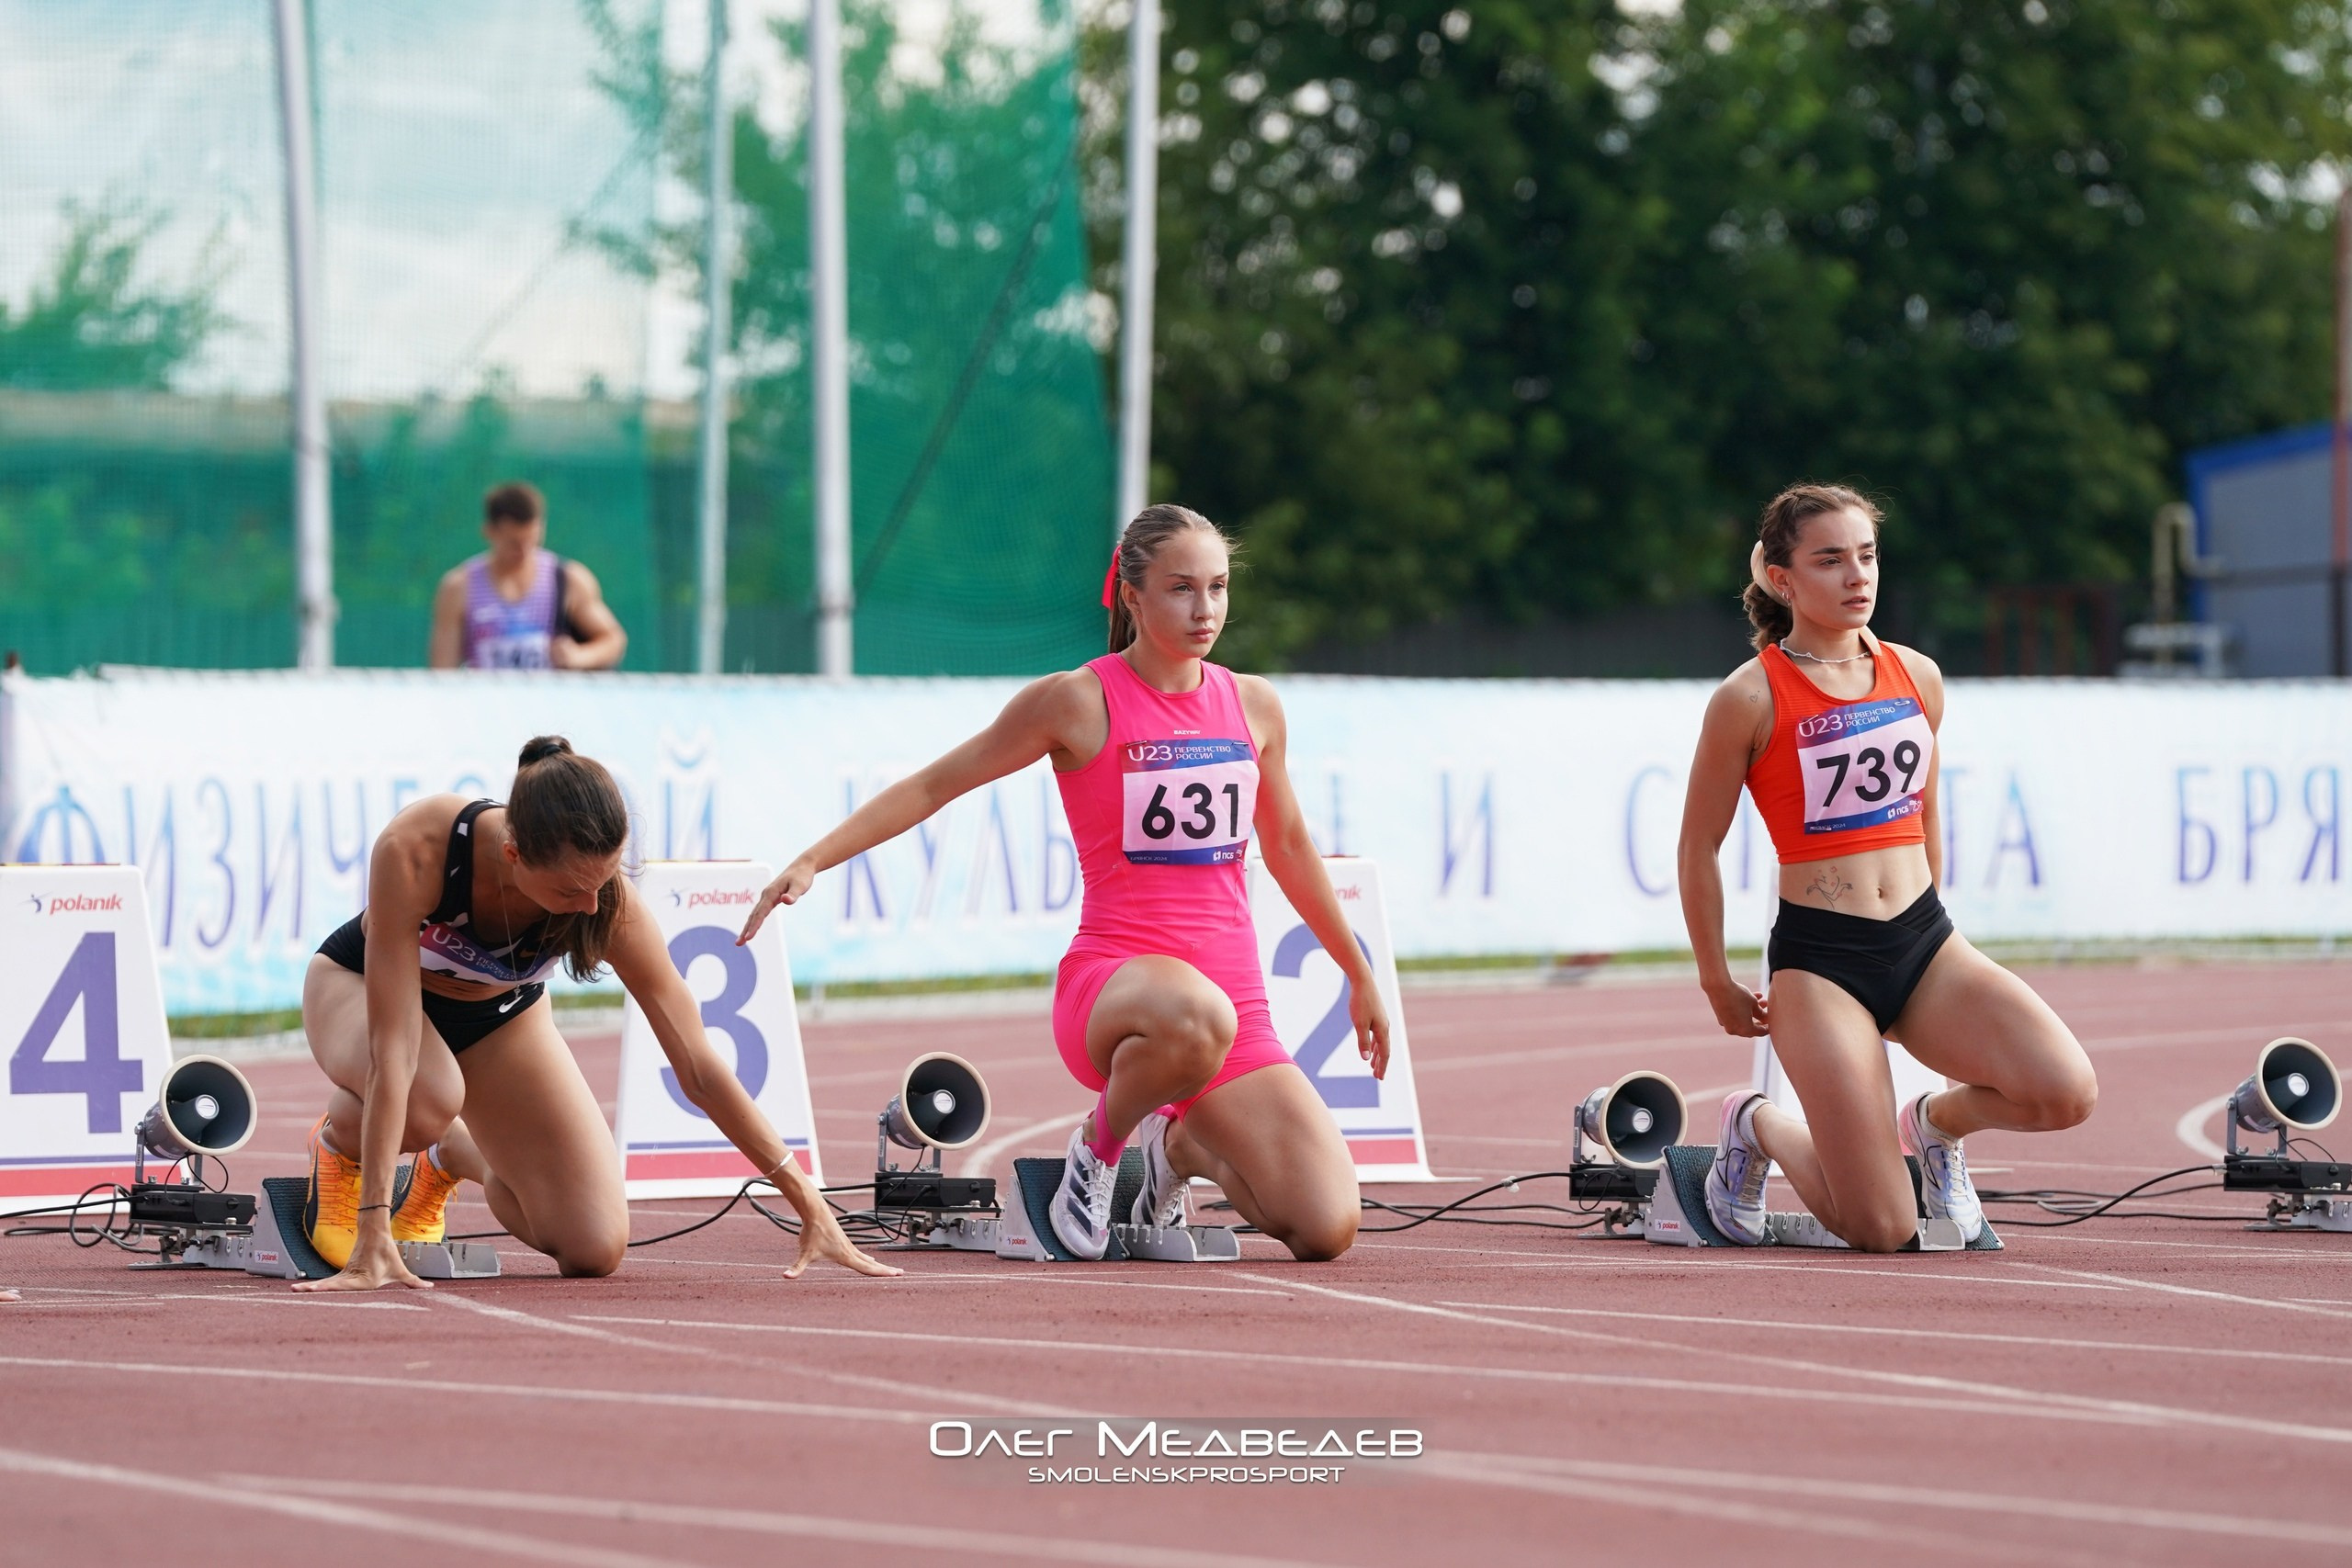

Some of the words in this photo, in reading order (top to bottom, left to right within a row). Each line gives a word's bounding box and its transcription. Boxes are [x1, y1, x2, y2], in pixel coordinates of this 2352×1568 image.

[1844, 706, 1895, 721] ПЕРВЕНСТВО
[1846, 716, 1881, 728] РОССИИ
[1798, 714, 1844, 738] U23
[1127, 745, 1173, 761] U23
[1174, 745, 1231, 753] ПЕРВЕНСТВО
[1175, 752, 1214, 761] РОССИИ
[1815, 739, 1921, 807] 739
[1141, 783, 1238, 840] 631
[1439, 770, 1494, 900] И
[50, 892, 123, 916] polanik
[687, 888, 755, 908] polanik
[432, 927, 476, 962] U23
[660, 925, 769, 1119] 3
[1272, 921, 1380, 1109] 2
[9, 931, 143, 1134] 4
